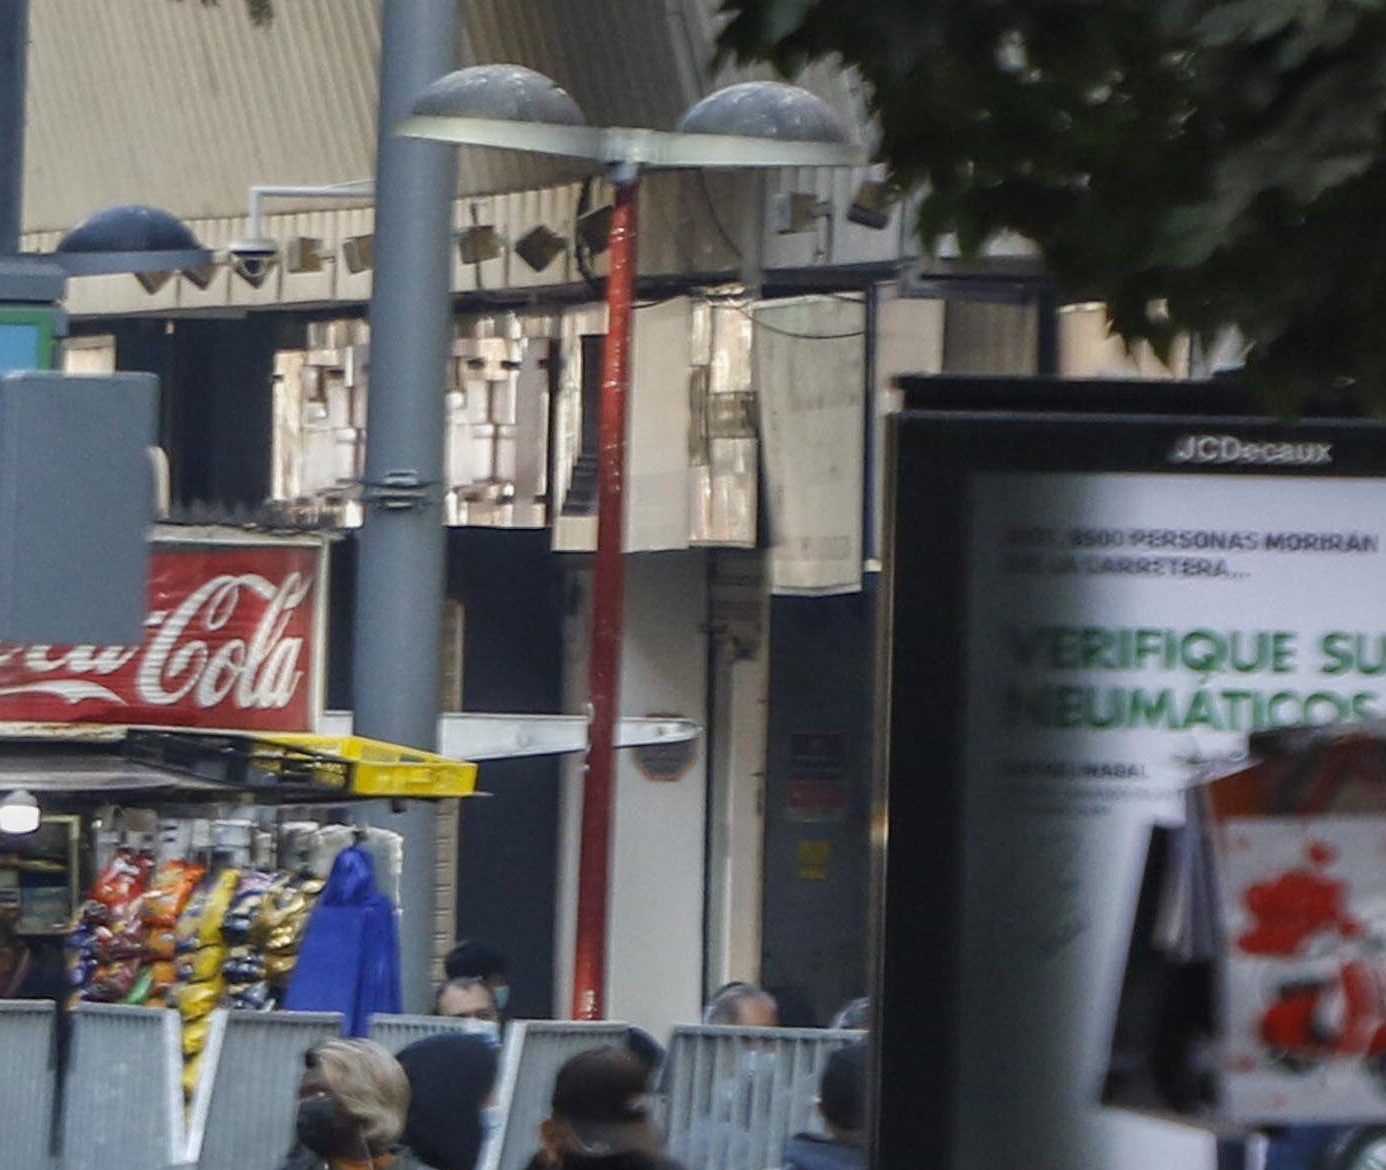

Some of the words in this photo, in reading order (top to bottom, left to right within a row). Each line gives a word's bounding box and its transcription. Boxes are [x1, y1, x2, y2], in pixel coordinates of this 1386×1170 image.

[1174, 436, 1333, 463] JCDecaux
[1131, 529, 1259, 551] PERSONAS
[1012, 626, 1299, 673] VERIFIQUE
